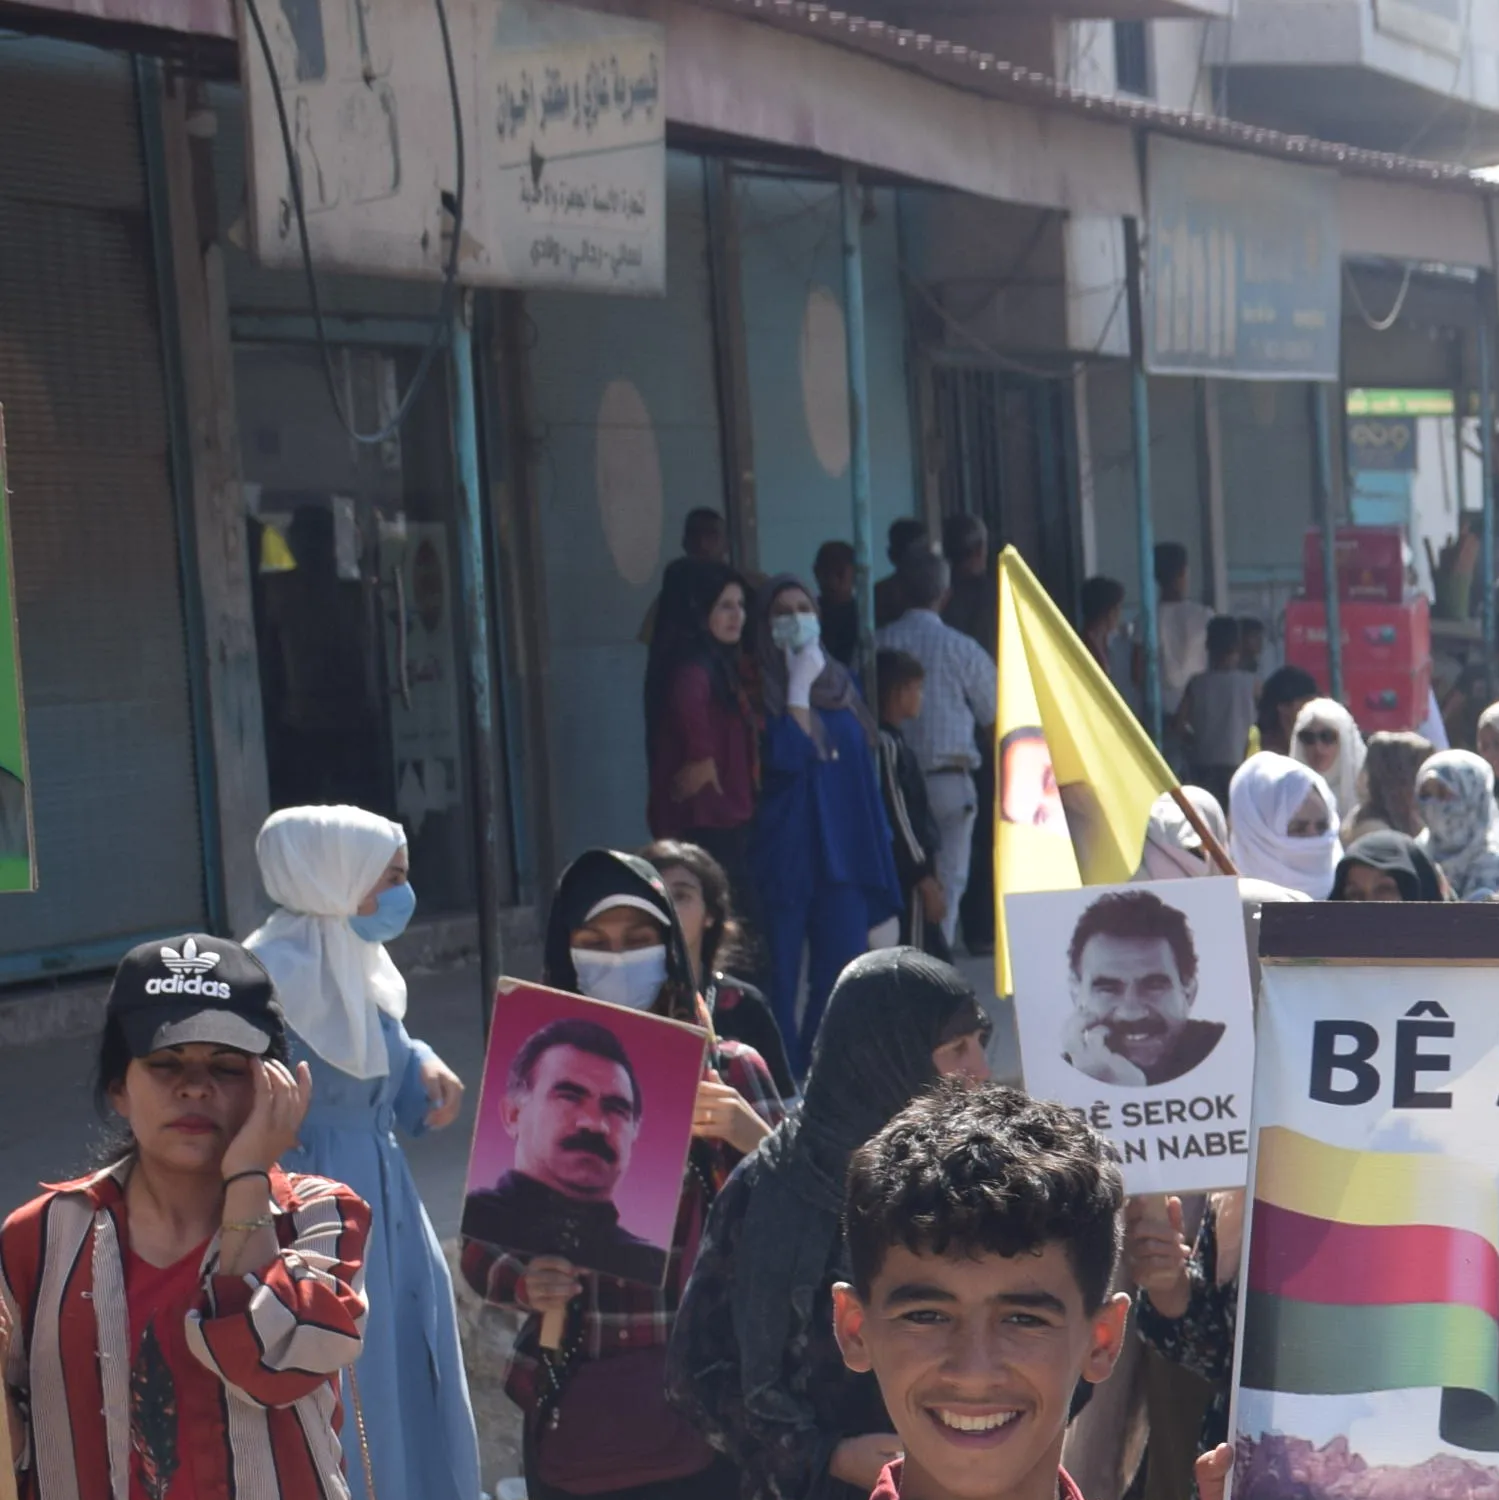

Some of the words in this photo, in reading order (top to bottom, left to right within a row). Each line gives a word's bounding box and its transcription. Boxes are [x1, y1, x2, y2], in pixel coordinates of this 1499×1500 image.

[145, 974, 231, 999] adidas
[1308, 1000, 1455, 1109] BÊ
[1121, 1094, 1238, 1128] SEROK
[1157, 1130, 1248, 1161] NABE
